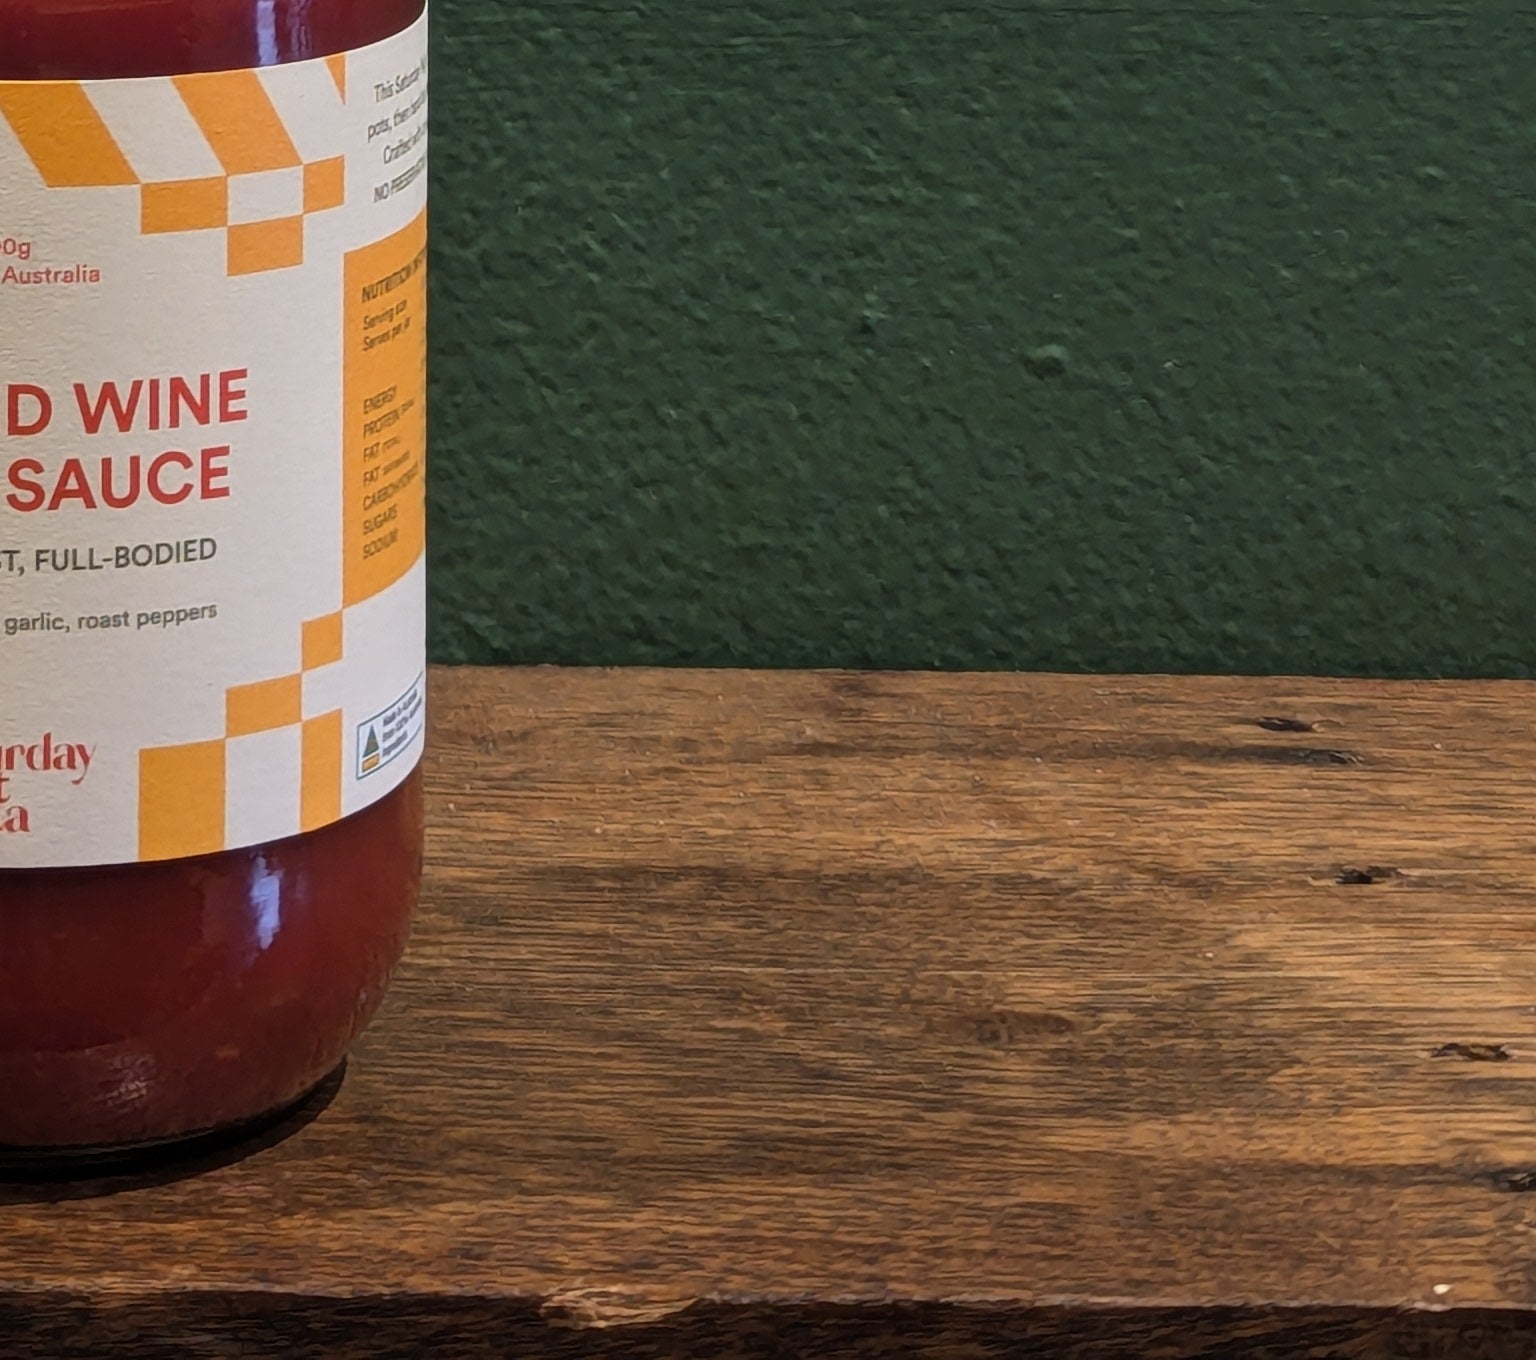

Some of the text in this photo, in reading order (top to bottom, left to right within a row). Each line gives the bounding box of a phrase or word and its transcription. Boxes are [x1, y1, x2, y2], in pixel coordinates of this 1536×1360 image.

[1, 263, 101, 285] Australia
[73, 368, 249, 435] WINE
[5, 445, 231, 512] SAUCE
[35, 537, 218, 571] FULL-BODIED
[4, 612, 71, 635] garlic,
[77, 609, 130, 631] roast
[136, 604, 218, 632] peppers
